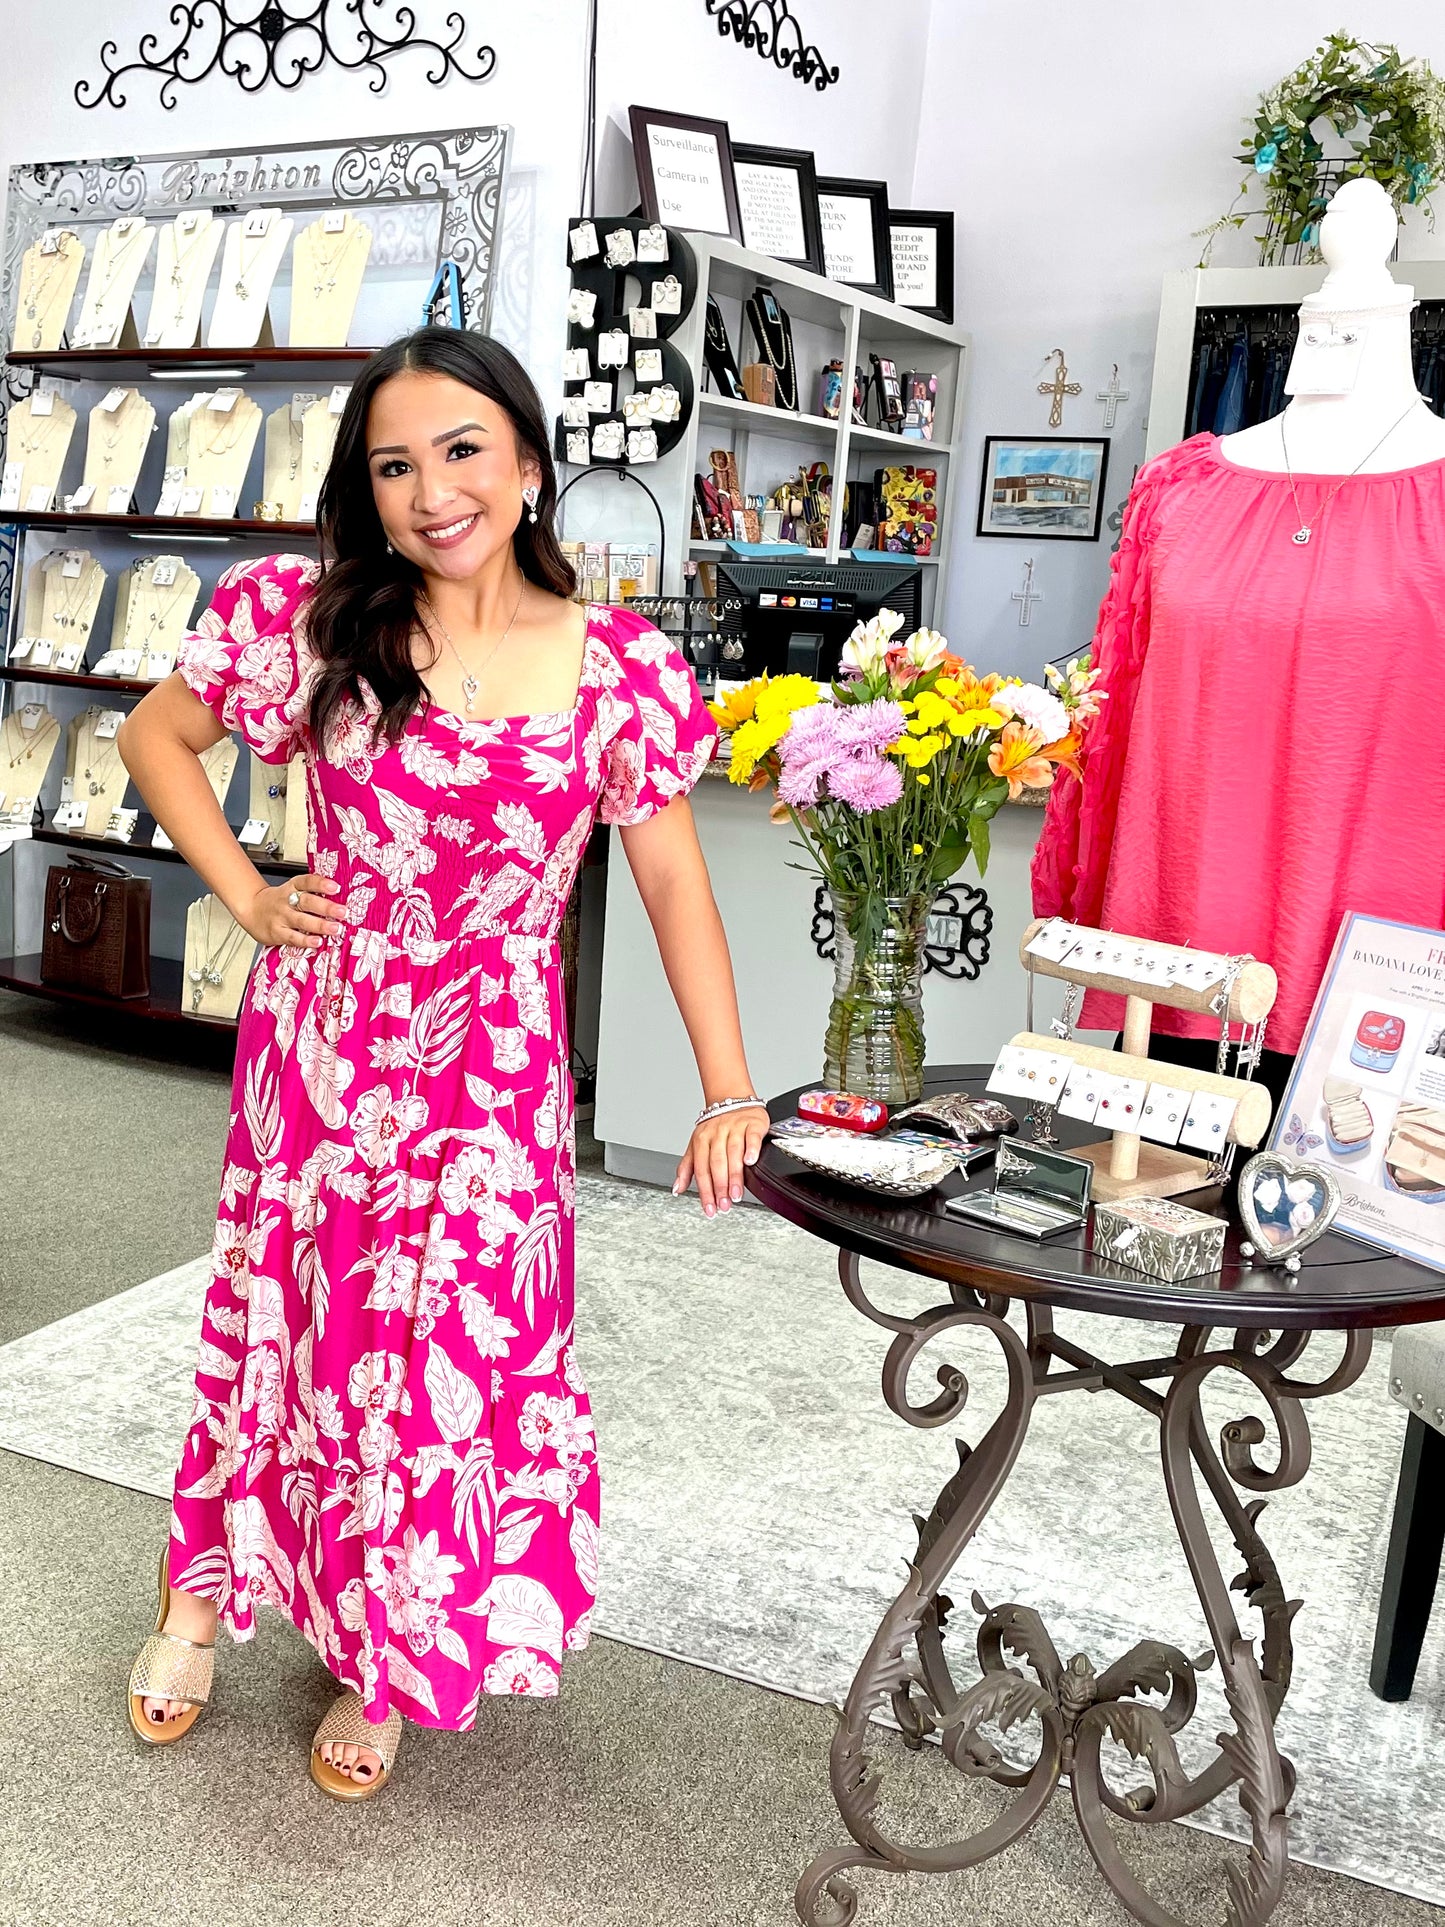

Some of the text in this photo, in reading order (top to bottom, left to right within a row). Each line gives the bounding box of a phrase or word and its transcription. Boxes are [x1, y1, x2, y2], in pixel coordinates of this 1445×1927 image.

[652, 134, 715, 154] Surveillance
[657, 166, 709, 184] Camera in
[154, 156, 321, 207] Brighton
[662, 198, 682, 212] Use
[823, 212, 846, 221] TURN
[823, 222, 843, 231] LICY
[890, 234, 909, 242] EBIT
[893, 244, 919, 252] REDIT
[824, 254, 854, 262] FUNDS
[891, 253, 929, 261] RCHASES
[907, 263, 926, 271] AND
[897, 272, 909, 280] UP
[907, 282, 924, 291] you!
[802, 599, 817, 607] VISA
[926, 915, 960, 947] ME
[1427, 948, 1445, 966] FR
[1353, 950, 1443, 981] BANDANA LOVE
[1341, 1193, 1386, 1218] Brighton
